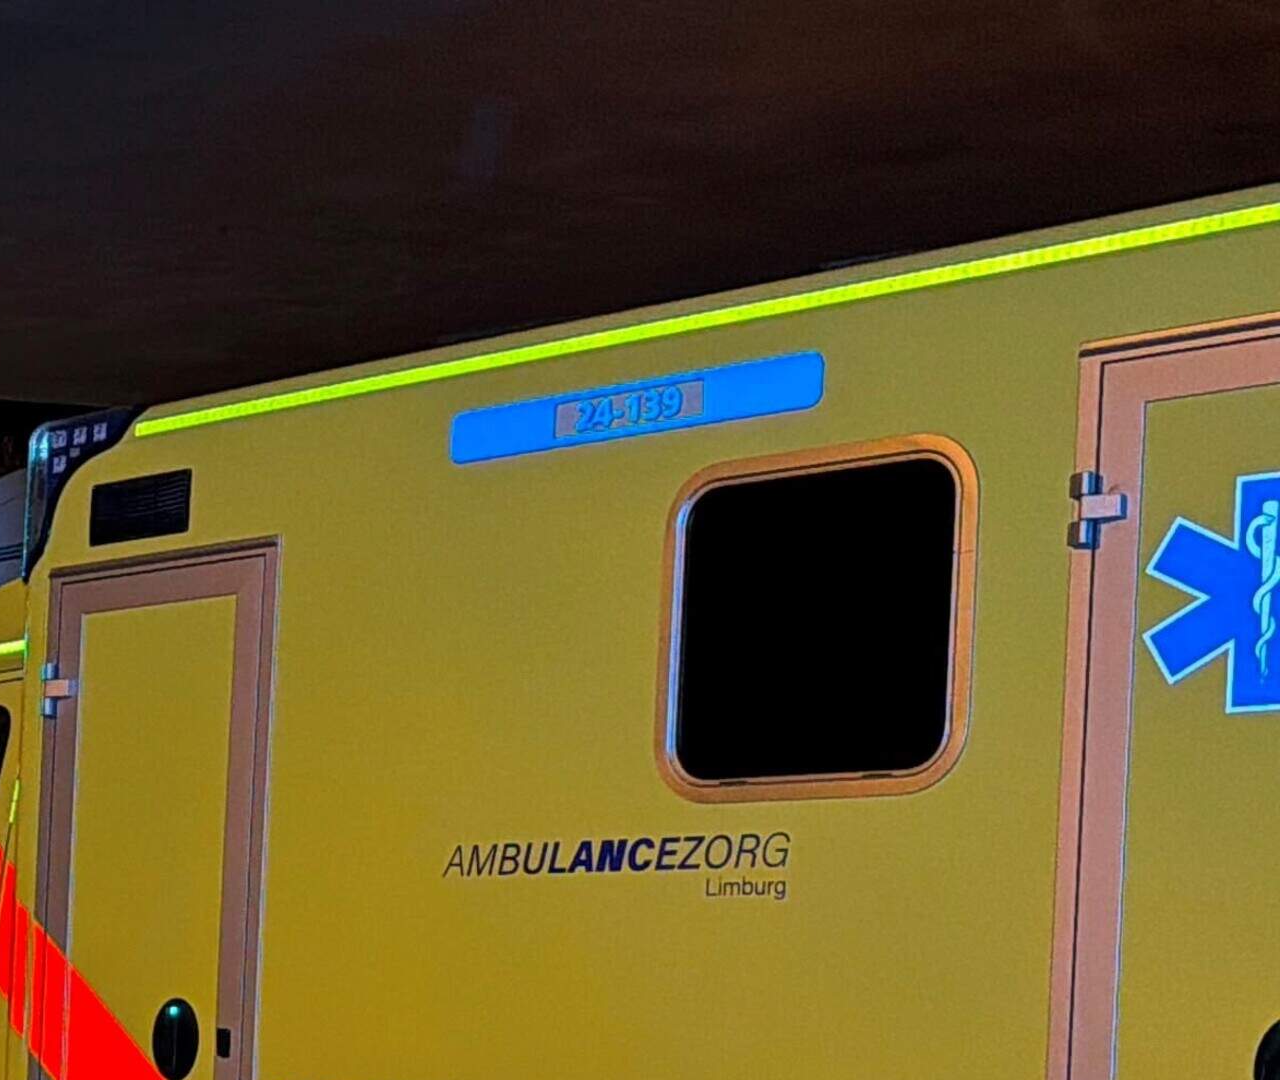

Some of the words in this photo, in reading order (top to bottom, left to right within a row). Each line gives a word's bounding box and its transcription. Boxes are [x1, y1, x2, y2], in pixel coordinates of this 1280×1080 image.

[576, 385, 683, 434] 24-139
[443, 832, 791, 878] AMBULANCEZORG
[705, 878, 787, 899] Limburg
